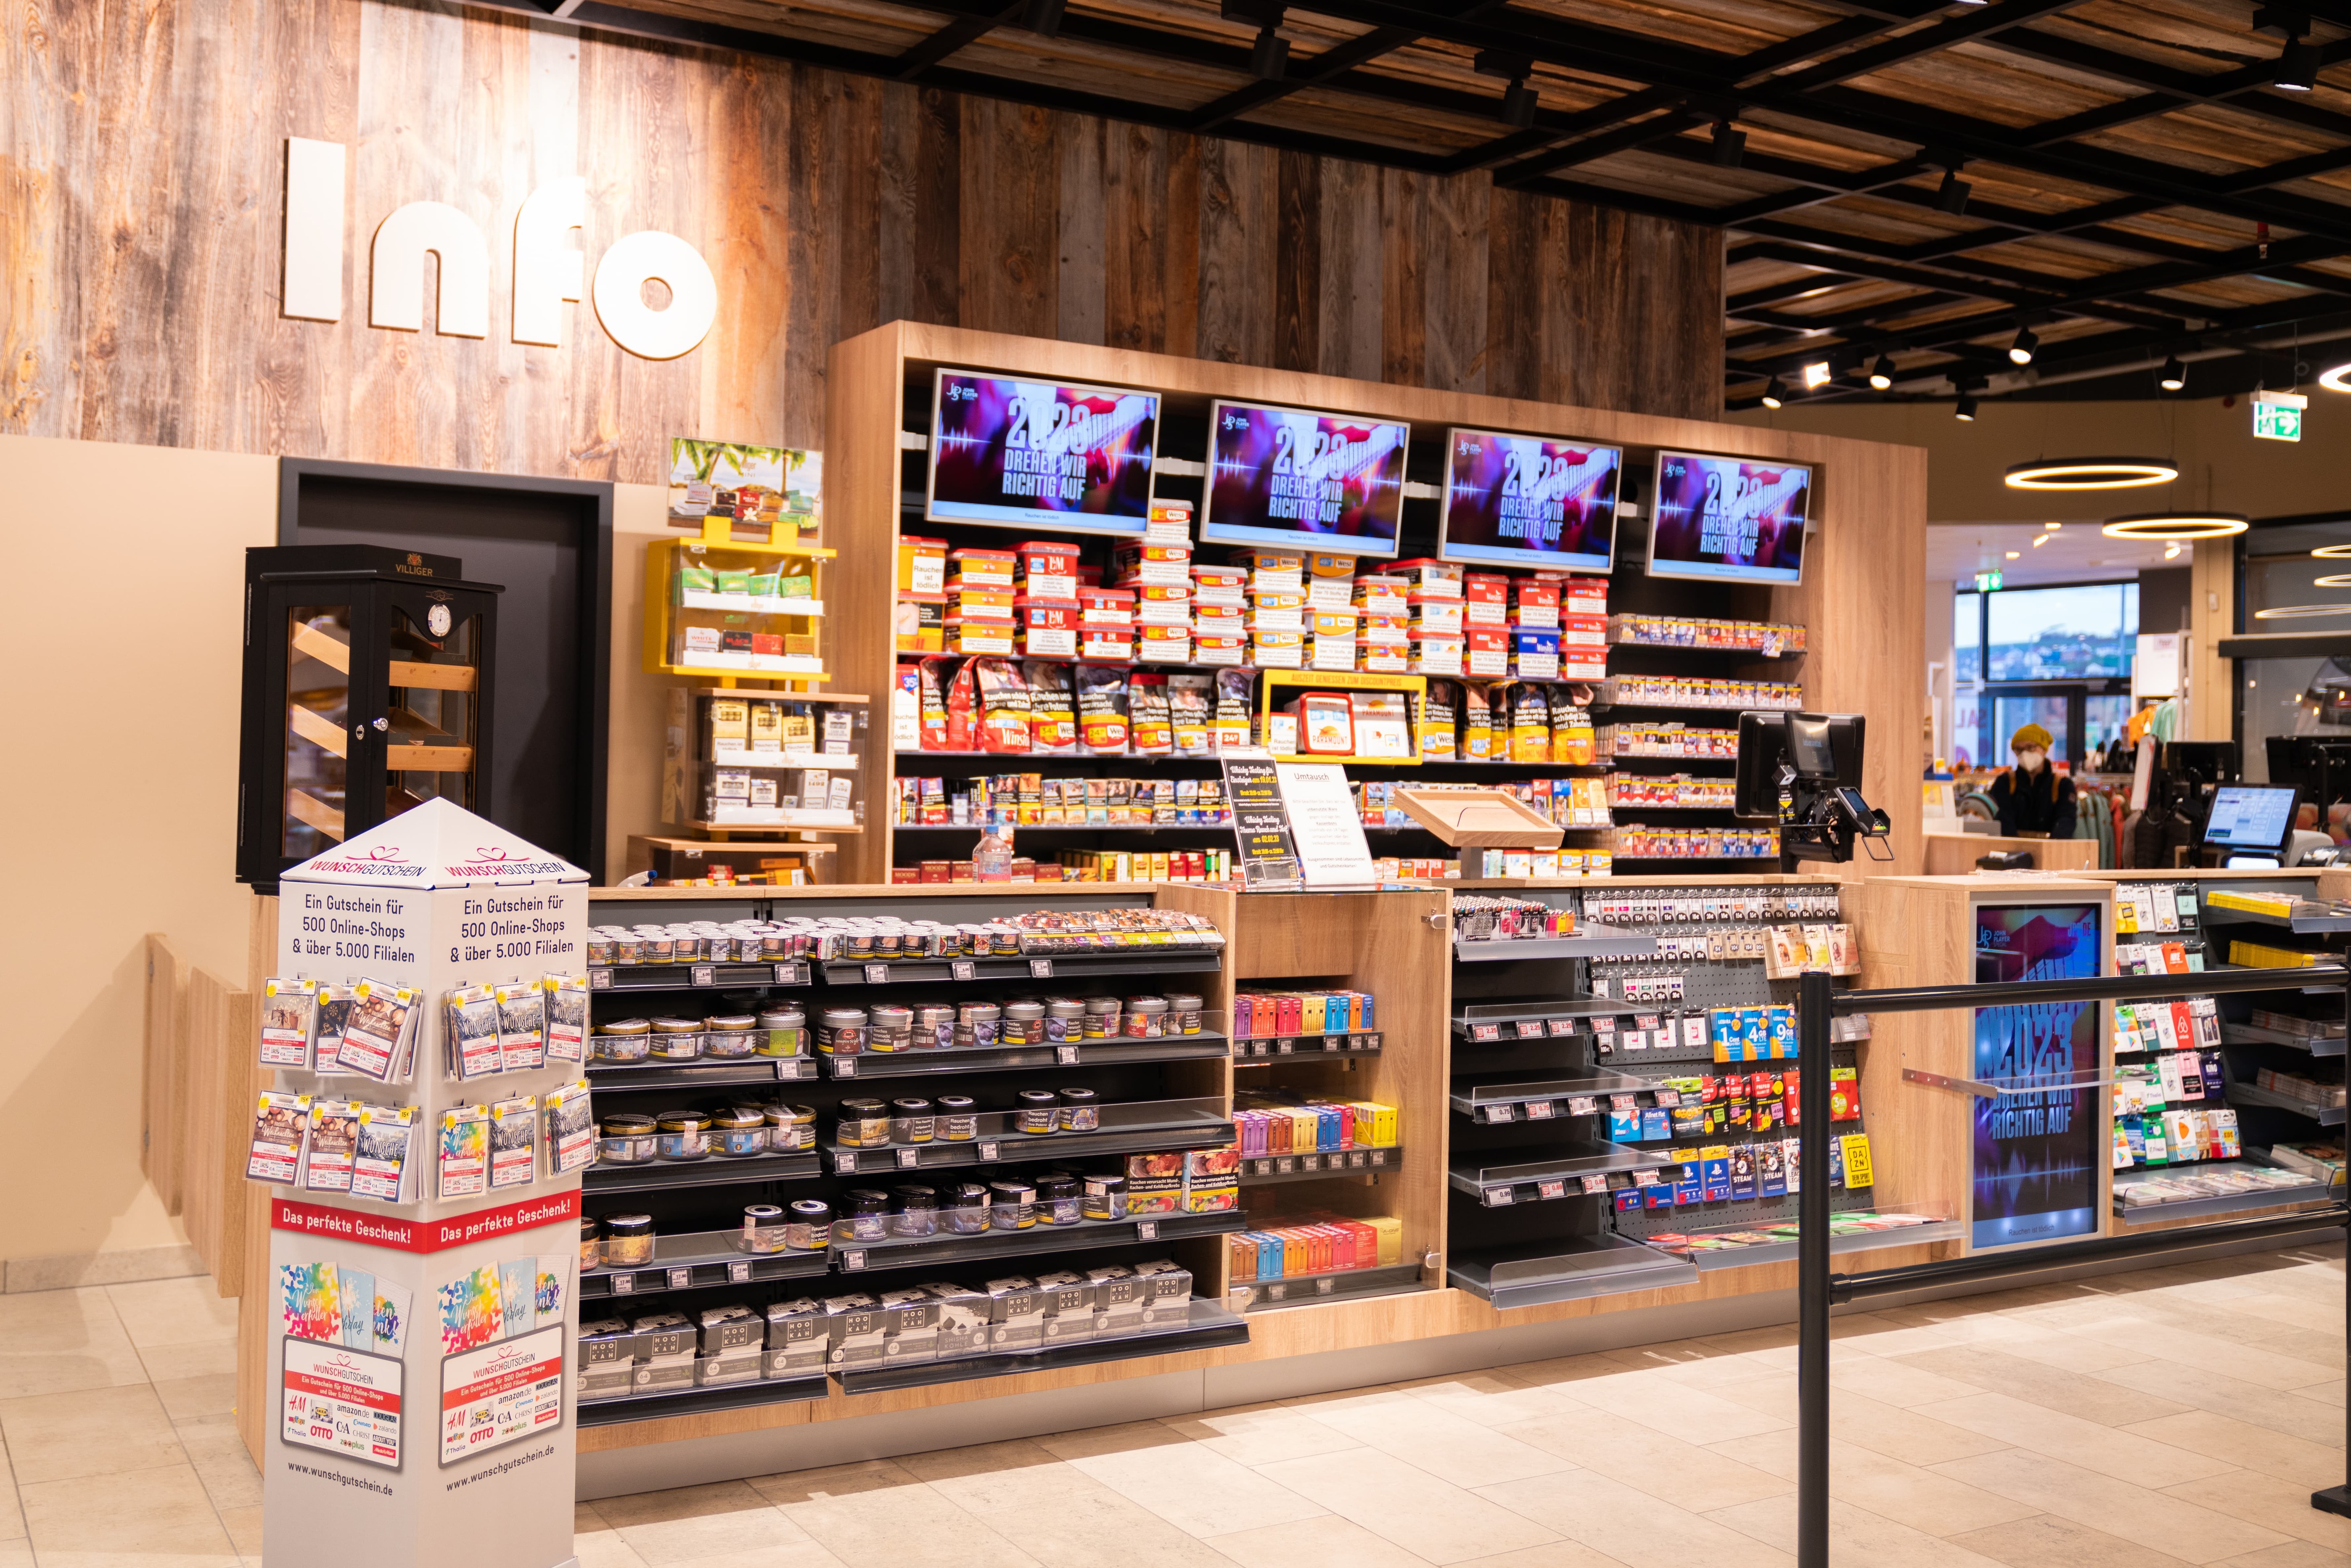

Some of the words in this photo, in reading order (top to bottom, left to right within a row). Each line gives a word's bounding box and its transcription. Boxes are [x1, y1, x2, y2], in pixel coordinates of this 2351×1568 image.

[281, 136, 718, 361] Info
[1006, 397, 1091, 454] 2023
[1272, 426, 1348, 480] 2023
[1004, 448, 1057, 474] DREHEN
[1060, 453, 1087, 477] WIR
[1502, 451, 1568, 501] 2023
[1002, 472, 1057, 497] RICHTIG
[1059, 476, 1086, 500] AUF
[1271, 474, 1316, 498] DREHEN
[1320, 480, 1343, 502] WIR
[1269, 496, 1316, 520] RICHTIG
[1318, 501, 1342, 522] AUF
[1500, 496, 1540, 518] DREHEN
[1544, 501, 1564, 521] WIR
[1499, 517, 1540, 538] RICHTIG
[1542, 521, 1563, 541] AUF
[1703, 515, 1738, 536] DREHEN
[1741, 519, 1759, 537] WIR
[1700, 534, 1738, 554] RICHTIG
[1739, 538, 1758, 556] AUF
[395, 564, 433, 576] VILLIGER
[1537, 643, 1554, 652] Winston
[1292, 674, 1314, 683] AUSZEIT
[1316, 675, 1345, 684] GENIESSEN
[1347, 676, 1358, 685] ZUM
[1361, 677, 1402, 687] DISCOUNTPREIS
[1362, 709, 1394, 717] PARAMOUNT
[1312, 735, 1348, 746] PARAMOUNT
[1230, 766, 1248, 776] Whisky
[1249, 766, 1265, 775] Tasting
[1294, 772, 1330, 781] Umtausch
[1230, 777, 1252, 786] Einsteiger
[1245, 816, 1262, 826] Whisky
[1262, 816, 1280, 825] Tasting
[310, 860, 426, 876] WUNSCHGUTSCHEIN
[445, 862, 566, 876] WUNSCHGUTSCHEIN
[305, 894, 322, 909] Ein
[327, 895, 382, 914] Gutschein
[386, 899, 403, 915] für
[464, 899, 482, 915] Ein
[487, 897, 543, 913] Gutschein
[547, 895, 564, 910] für
[303, 917, 326, 933] 500
[330, 919, 405, 941] Online-Shops
[461, 923, 485, 938] 500
[490, 919, 565, 938] Online-Shops
[292, 939, 301, 953] &
[306, 940, 331, 956] über
[336, 942, 369, 959] 5.000
[374, 945, 414, 963] Filialen
[450, 948, 460, 962] &
[465, 945, 491, 961] über
[496, 942, 531, 958] 5.000
[535, 939, 574, 955] Filialen
[503, 1013, 536, 1029] WÜNSCHE
[554, 1004, 579, 1021] WÜNSCHE
[1749, 1025, 1759, 1042] 4
[1993, 1012, 2073, 1079] 2023
[1993, 1108, 2044, 1140] RICHTIG
[2047, 1105, 2072, 1135] AUF
[363, 1136, 399, 1157] WÜNSCHE
[1764, 1171, 1783, 1180] STEAM
[283, 1208, 303, 1224] Das
[307, 1214, 352, 1234] perfekte
[355, 1221, 411, 1244] Geschenk!
[441, 1226, 461, 1243] Das
[466, 1214, 513, 1236] perfekte
[517, 1203, 570, 1224] Geschenk!
[2009, 1227, 2031, 1237] Rauchen
[2038, 1223, 2055, 1234] tödlich
[313, 1363, 373, 1385] WUNSCHGUTSCHEIN
[473, 1352, 536, 1379] WUNSCHGUTSCHEIN
[470, 1381, 494, 1393] Gutschein
[515, 1365, 545, 1379] Online-Shops
[310, 1378, 333, 1388] Gutschein
[342, 1384, 352, 1393] 500
[353, 1387, 384, 1401] Online-Shops
[338, 1392, 350, 1400] 5.000
[351, 1395, 365, 1404] Filialen
[289, 1395, 307, 1413] H&M
[337, 1404, 370, 1418] amazon.de
[288, 1416, 305, 1425] myToys
[353, 1419, 371, 1428] CONRAD
[373, 1411, 397, 1423] DOUGLAS
[291, 1428, 306, 1437] Thalia
[310, 1425, 333, 1440] OTTO
[336, 1421, 350, 1434] C&A
[353, 1429, 370, 1440] CHRIST
[379, 1424, 397, 1434] zalando
[340, 1439, 364, 1450] zooplus
[373, 1434, 386, 1444] ABOUT
[447, 1444, 554, 1492] www.wunschgutschein.de
[288, 1462, 393, 1496] www.wunschgutschein.de
